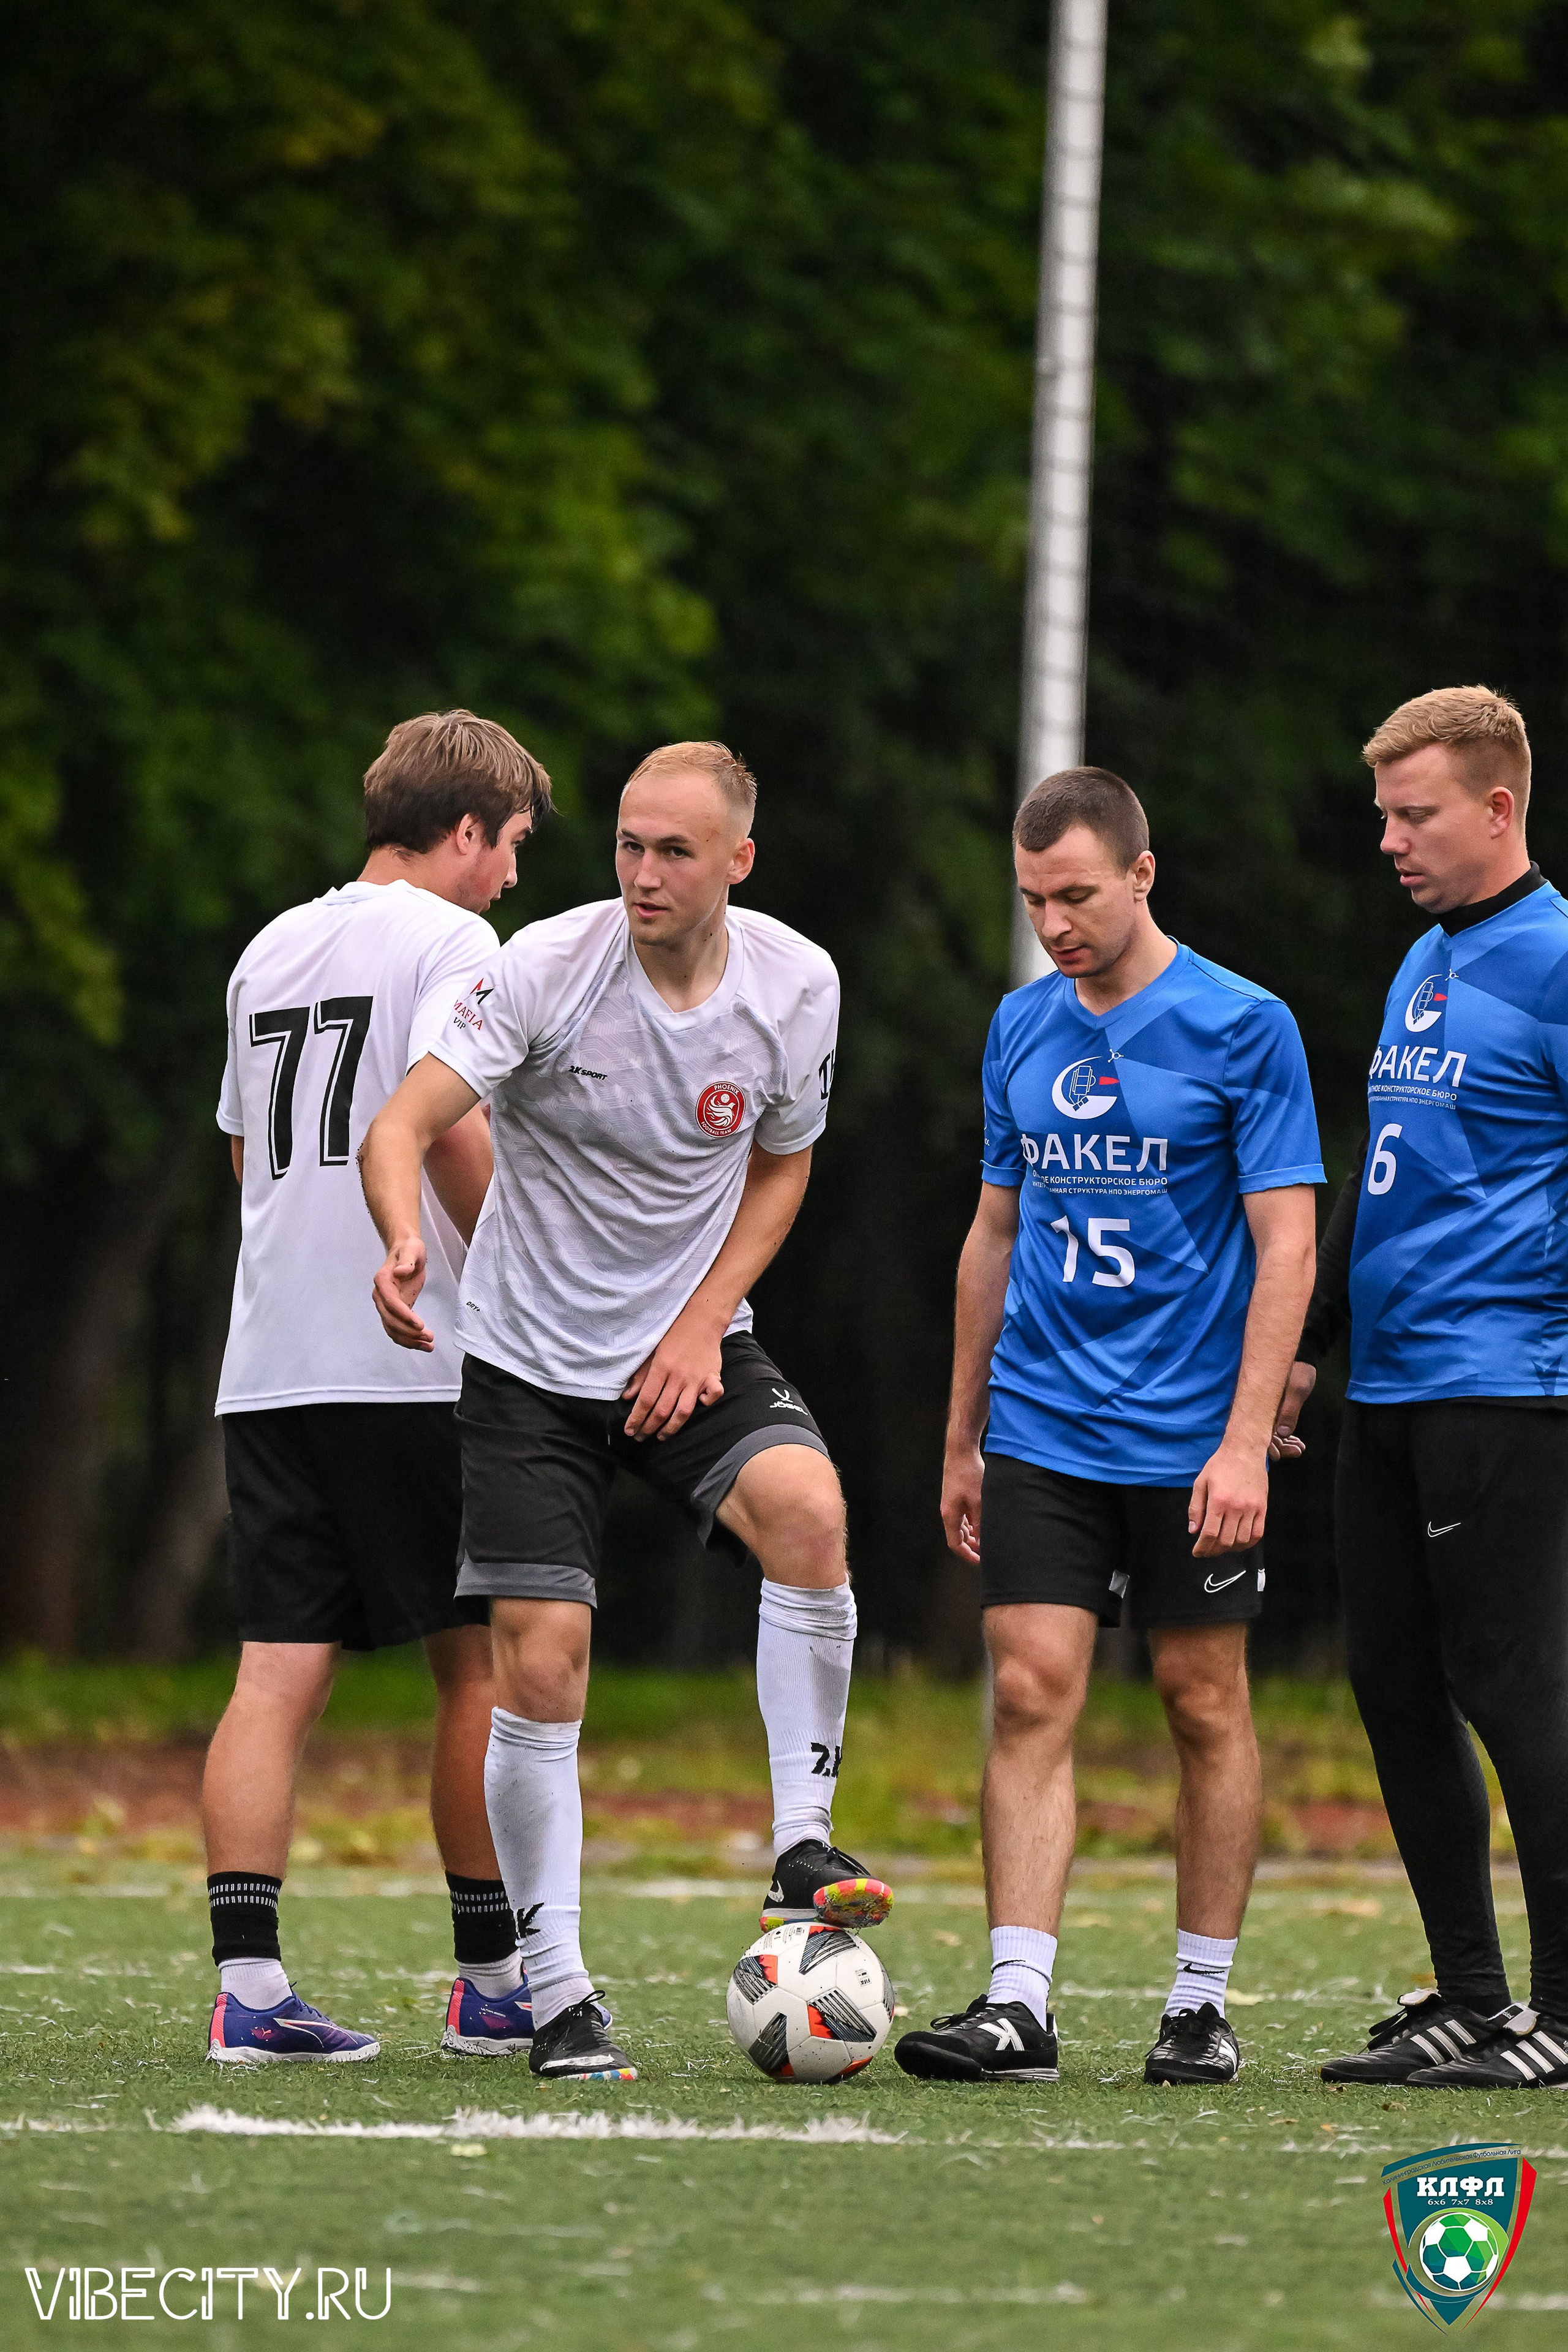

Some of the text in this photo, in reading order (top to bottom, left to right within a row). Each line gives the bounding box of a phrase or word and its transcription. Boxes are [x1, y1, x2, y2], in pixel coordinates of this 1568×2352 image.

[454, 999, 483, 1030] MAFIA
[453, 1017, 466, 1029] VIP
[1369, 1045, 1468, 1087] ФАКЕЛ
[249, 996, 374, 1180] 77
[714, 1084, 739, 1095] PHOENIX
[1381, 1085, 1431, 1096] КОНСТРУКТОРСКОЕ
[1432, 1090, 1457, 1101] БЮРО
[1419, 1099, 1456, 1110] ЭНЕРГОМАШ
[701, 1121, 719, 1135] FOOTBALL
[1020, 1134, 1168, 1172] ФАКЕЛ
[1368, 1123, 1403, 1195] 6
[1050, 1176, 1137, 1186] КОНСТРУКТОРСКОЕ
[1139, 1177, 1168, 1186] БЮРО
[1123, 1188, 1168, 1196] ЭНЕРГОМАШ
[1050, 1215, 1135, 1287] 15
